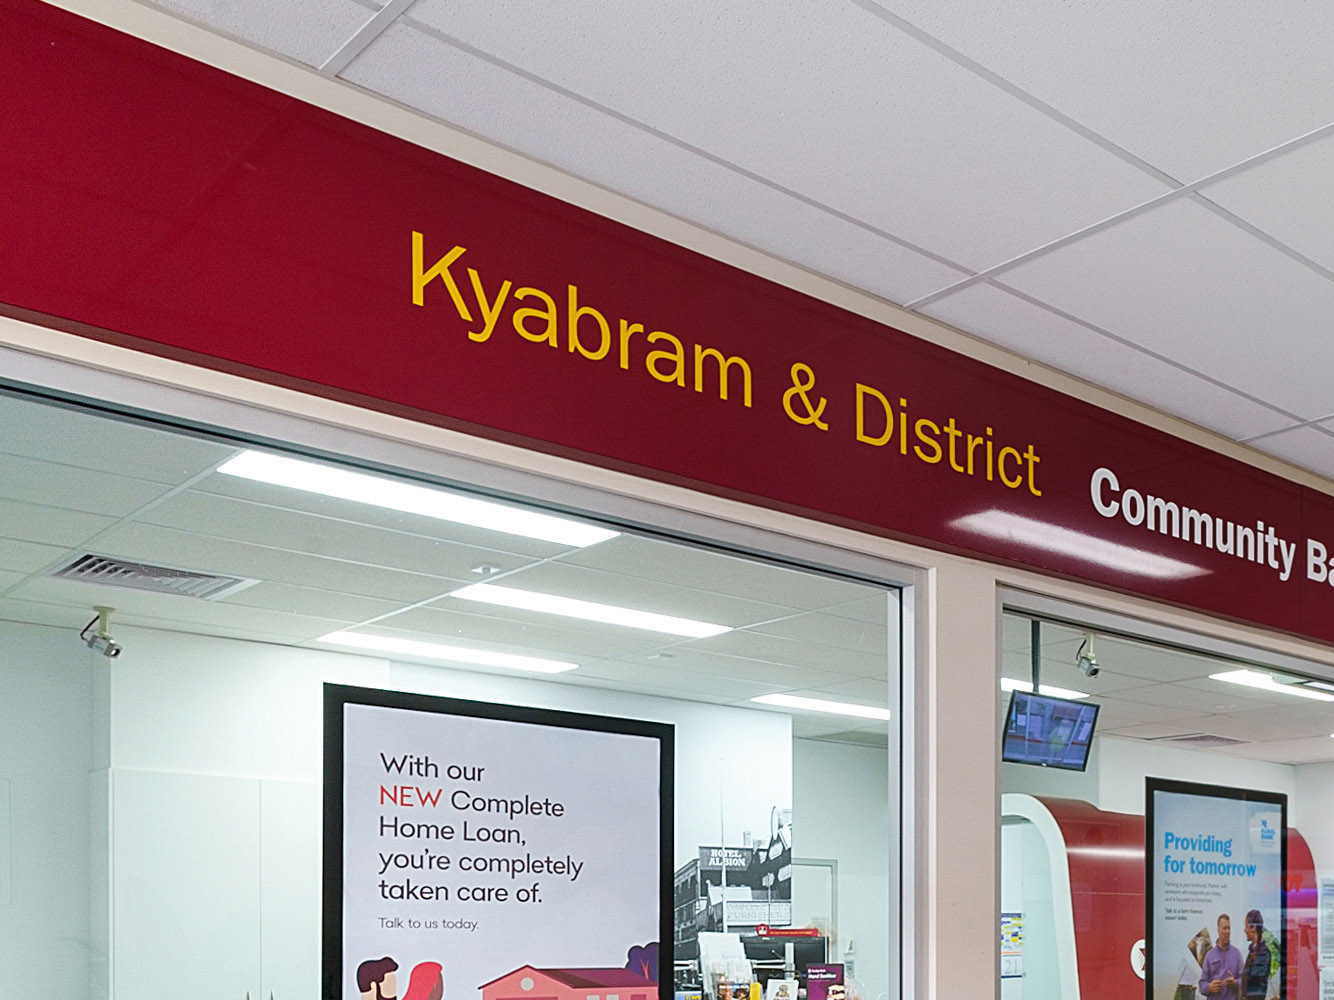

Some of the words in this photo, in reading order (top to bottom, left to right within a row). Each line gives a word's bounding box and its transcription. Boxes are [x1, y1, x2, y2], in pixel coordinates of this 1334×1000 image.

[410, 230, 752, 408] Kyabram
[781, 361, 830, 432] &
[855, 382, 1042, 496] District
[1090, 467, 1296, 582] Community
[380, 753, 438, 778] With
[447, 764, 485, 782] our
[380, 785, 443, 808] NEW
[451, 790, 565, 820] Complete
[380, 816, 455, 841] Home
[463, 821, 527, 847] Loan,
[1164, 832, 1233, 857] Providing
[379, 848, 451, 875] you're
[459, 853, 584, 881] completely
[708, 858, 746, 867] ALBION
[711, 849, 742, 858] HOTEL
[1164, 855, 1186, 873] for
[1190, 857, 1257, 877] tomorrow
[379, 879, 449, 901] taken
[457, 885, 509, 902] care
[516, 883, 543, 903] of.
[378, 917, 403, 929] Talk
[408, 918, 421, 929] to
[424, 920, 438, 929] us
[442, 918, 480, 932] today.
